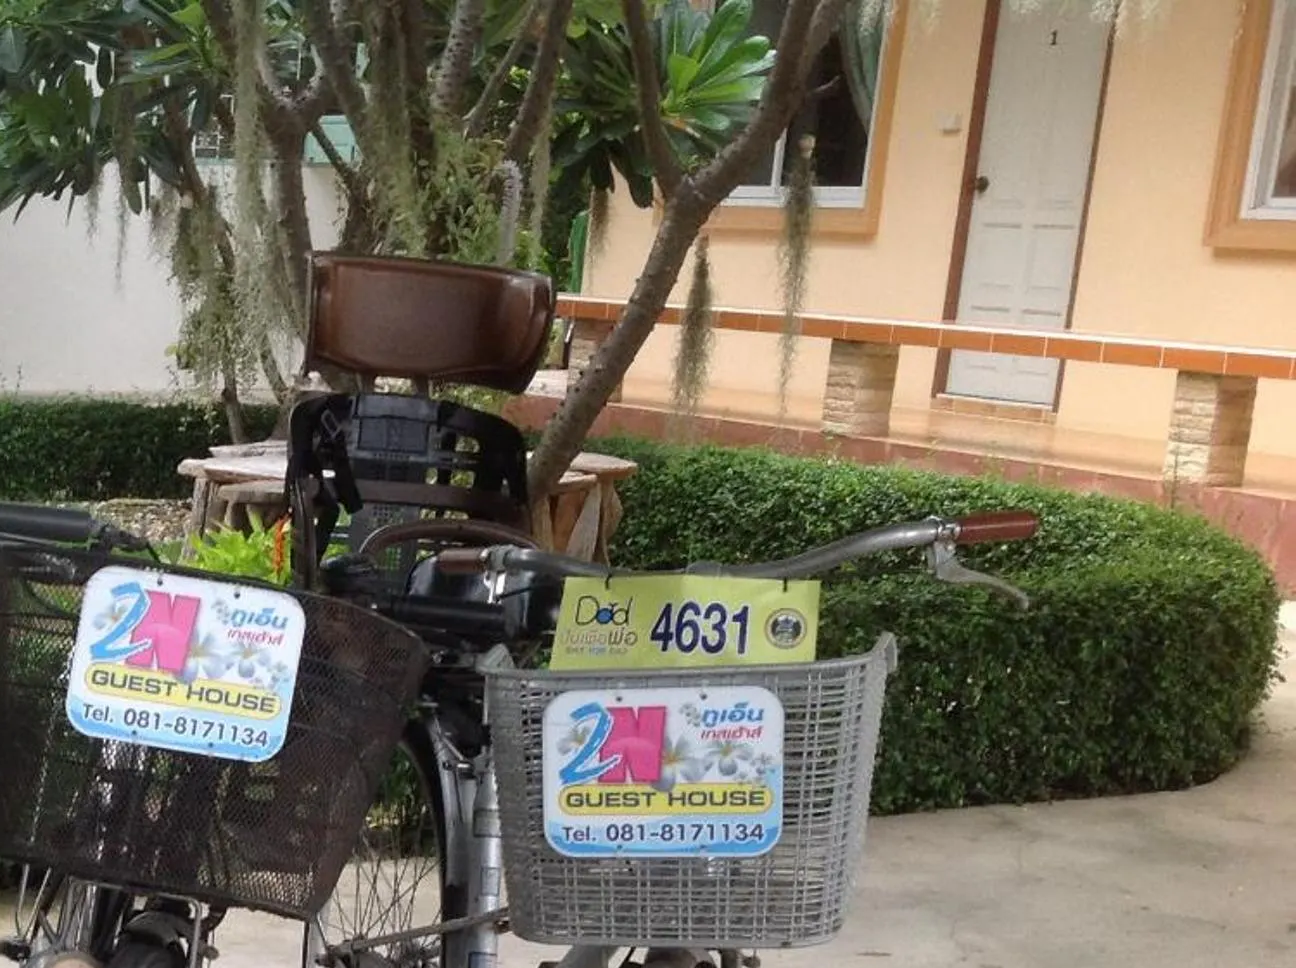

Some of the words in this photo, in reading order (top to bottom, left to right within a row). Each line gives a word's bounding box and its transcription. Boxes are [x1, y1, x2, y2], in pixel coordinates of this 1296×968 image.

[90, 582, 201, 676] 2N
[650, 602, 749, 654] 4631
[91, 670, 177, 696] GUEST
[186, 684, 276, 713] HOUSE
[83, 704, 114, 723] Tel.
[124, 708, 268, 747] 081-8171134
[559, 702, 666, 785] 2N
[566, 792, 657, 808] GUEST
[668, 791, 765, 806] HOUSE
[563, 826, 596, 842] Tel.
[606, 824, 764, 842] 081-8171134
